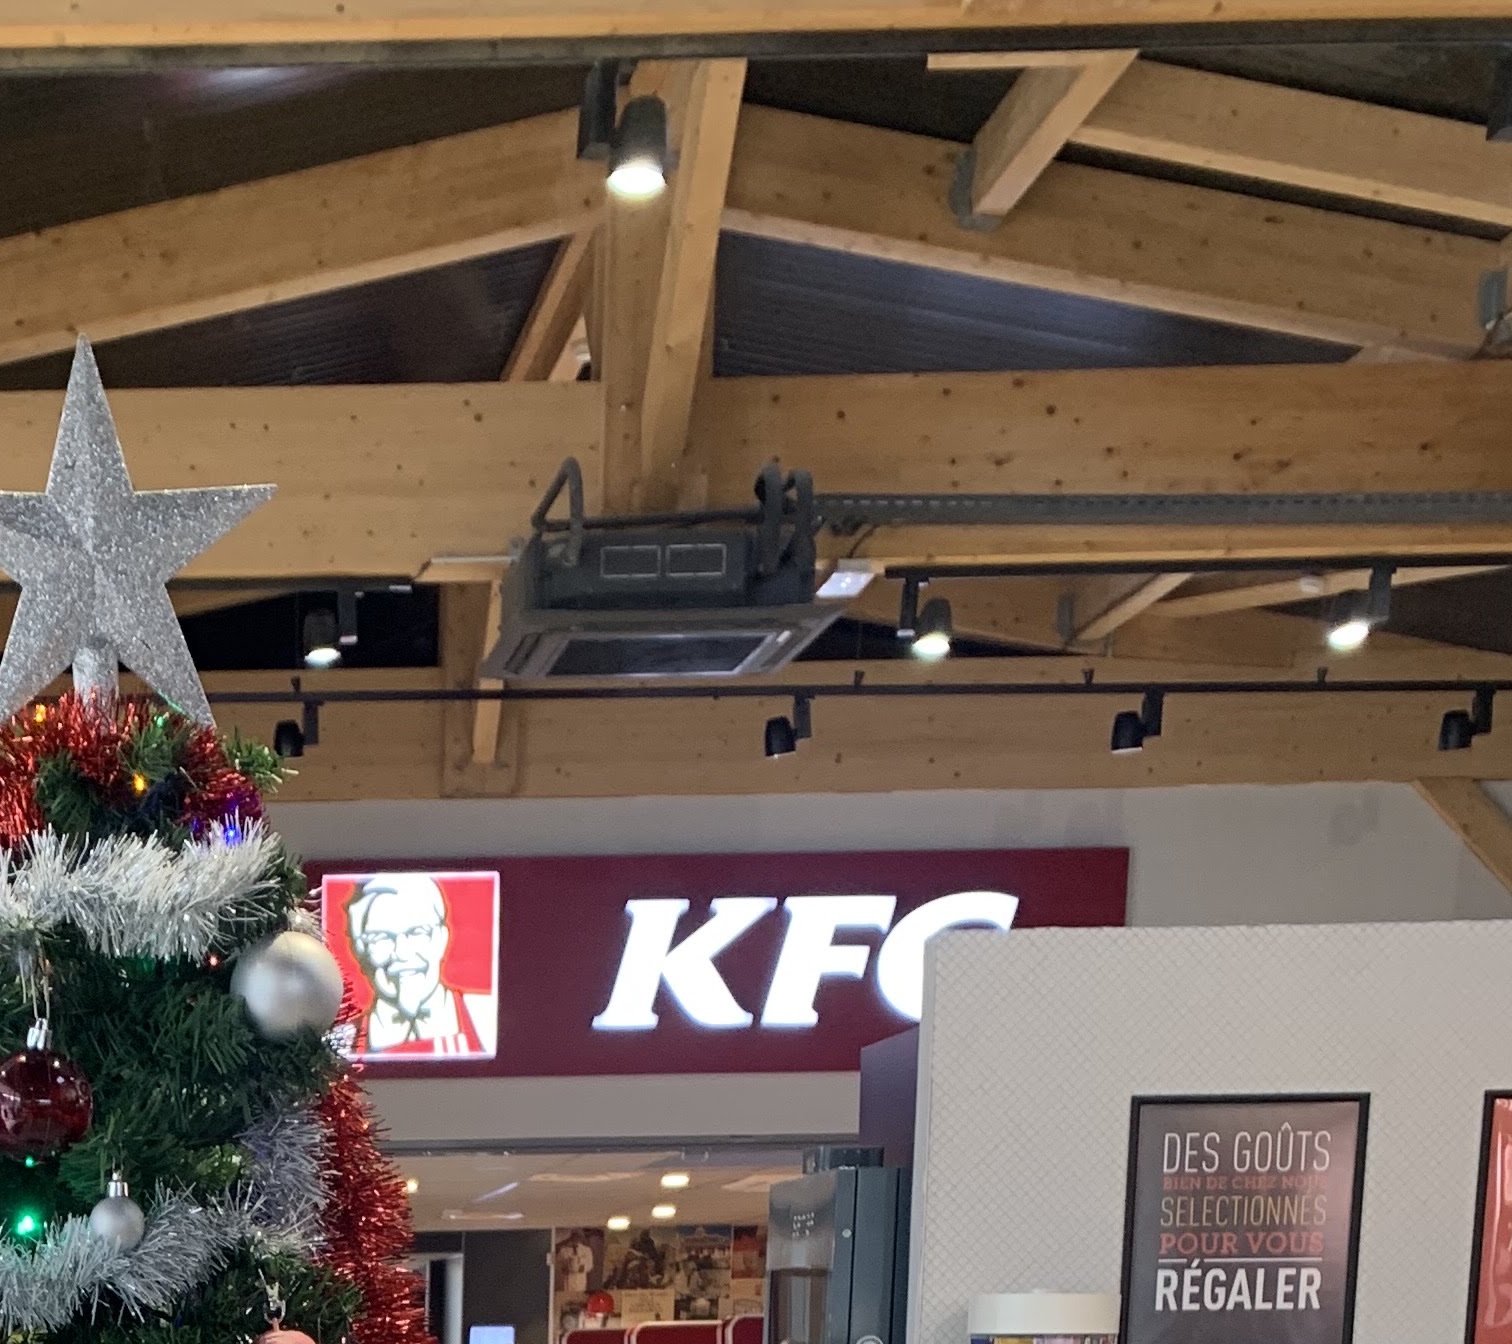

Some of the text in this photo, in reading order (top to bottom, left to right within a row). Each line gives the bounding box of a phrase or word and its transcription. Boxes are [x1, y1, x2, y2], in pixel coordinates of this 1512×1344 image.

[591, 891, 1020, 1030] KFC
[1163, 1121, 1331, 1174] DES GOÛTS
[1162, 1175, 1202, 1191] BIEN
[1206, 1175, 1227, 1190] DE
[1231, 1175, 1276, 1190] CHEZ
[1159, 1231, 1324, 1256] POUR VOUS
[1155, 1258, 1322, 1311] RÉGALER
